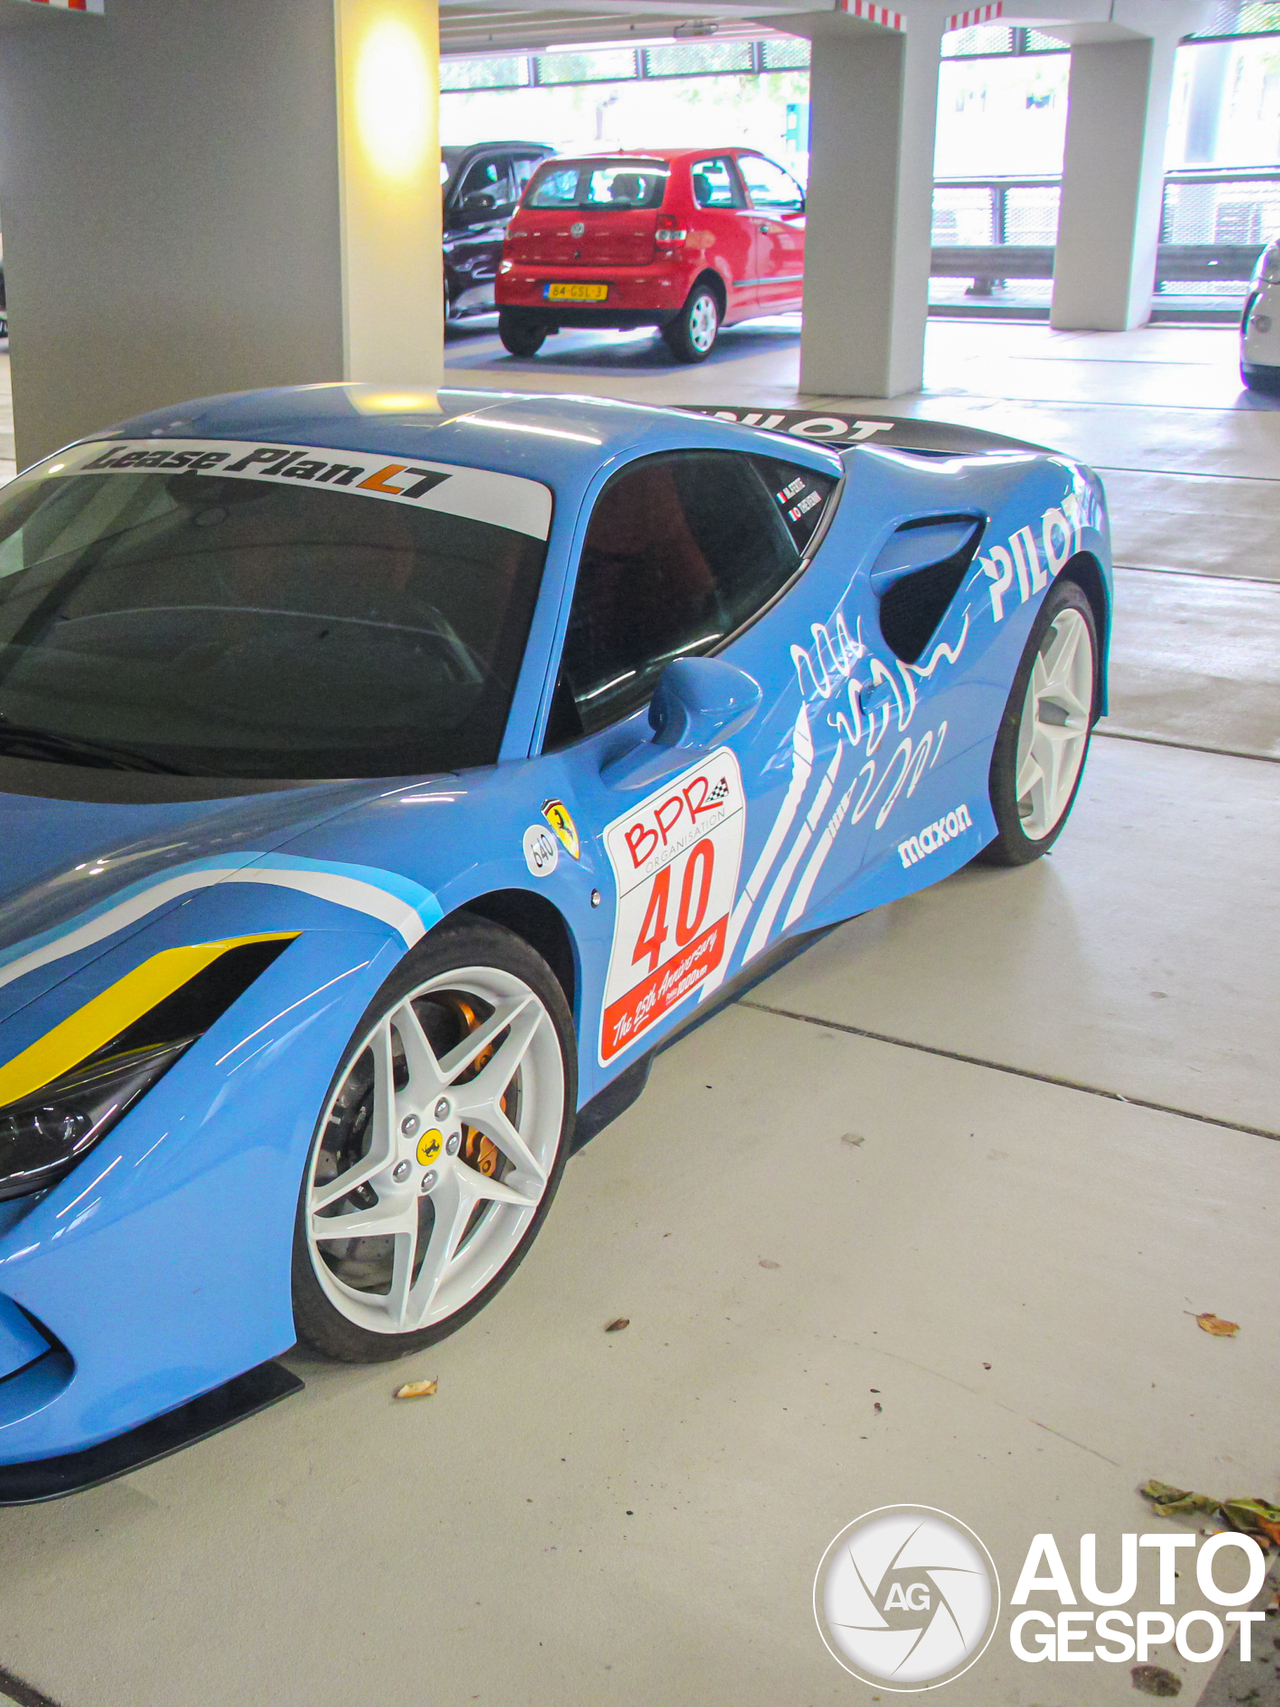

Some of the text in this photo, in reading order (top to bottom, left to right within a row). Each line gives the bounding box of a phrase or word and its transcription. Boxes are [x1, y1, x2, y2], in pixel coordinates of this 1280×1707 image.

[552, 286, 602, 298] 84-GSL-3
[82, 446, 365, 485] Lease Plan
[625, 776, 724, 869] BPR
[645, 808, 726, 874] ORGANISATION
[898, 804, 973, 869] maxon
[631, 838, 715, 974] 40
[613, 1012, 633, 1047] The
[658, 929, 718, 1001] Anniversary
